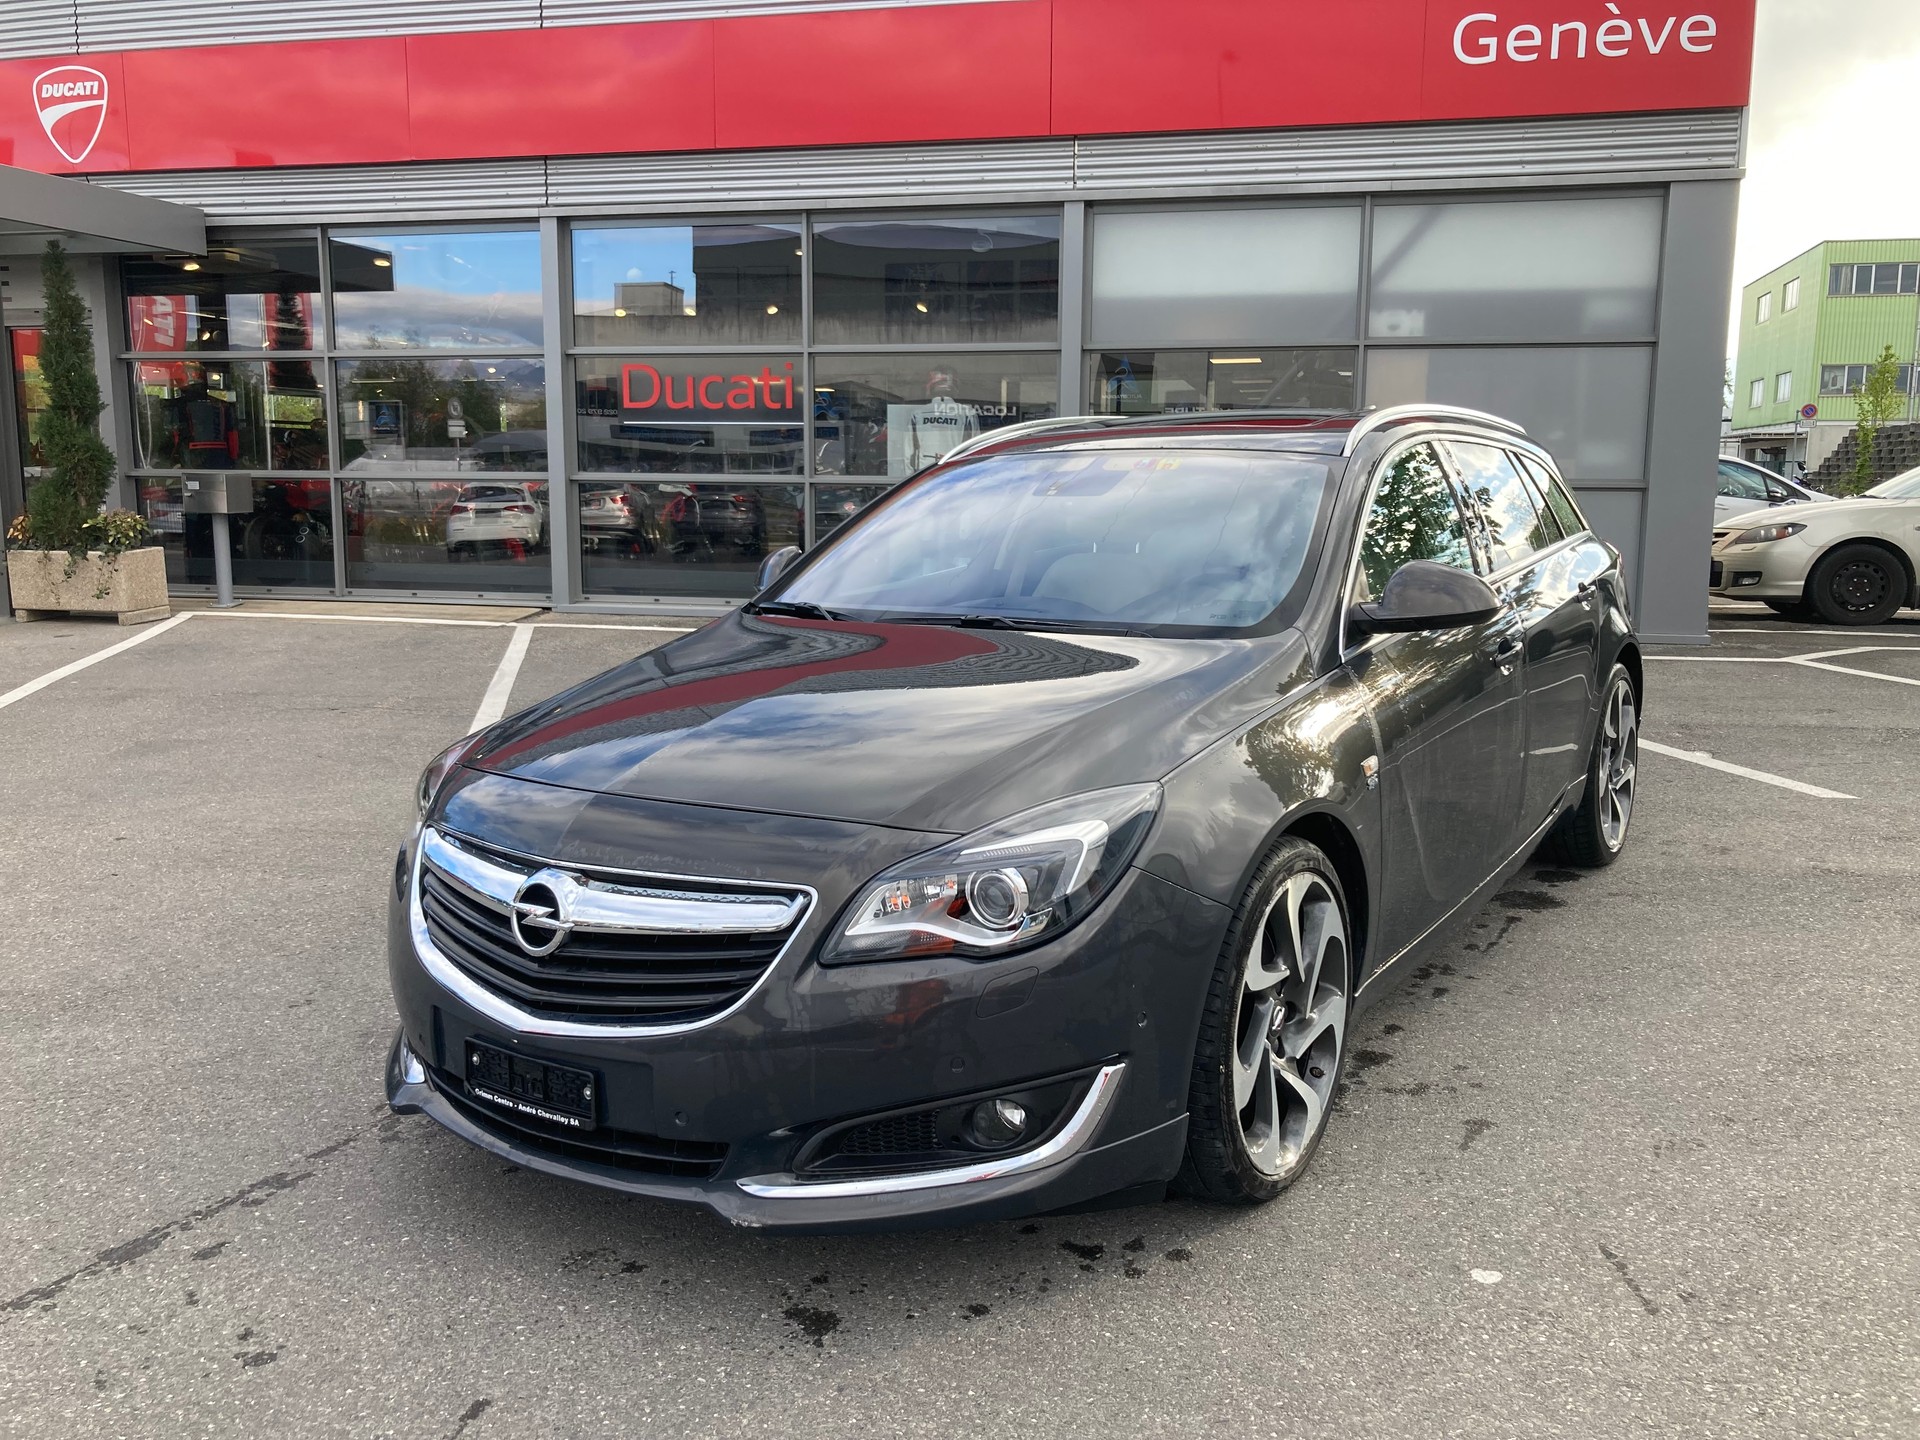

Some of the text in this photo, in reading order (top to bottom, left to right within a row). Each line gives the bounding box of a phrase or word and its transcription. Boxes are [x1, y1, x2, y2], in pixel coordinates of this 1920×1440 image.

[1453, 3, 1717, 65] Genève
[41, 81, 99, 98] DUCATI
[622, 361, 793, 409] Ducati
[923, 417, 958, 426] DUCATI
[494, 1095, 513, 1107] Centre
[518, 1103, 537, 1115] André
[537, 1109, 568, 1124] Chevalley
[570, 1118, 580, 1126] SA
